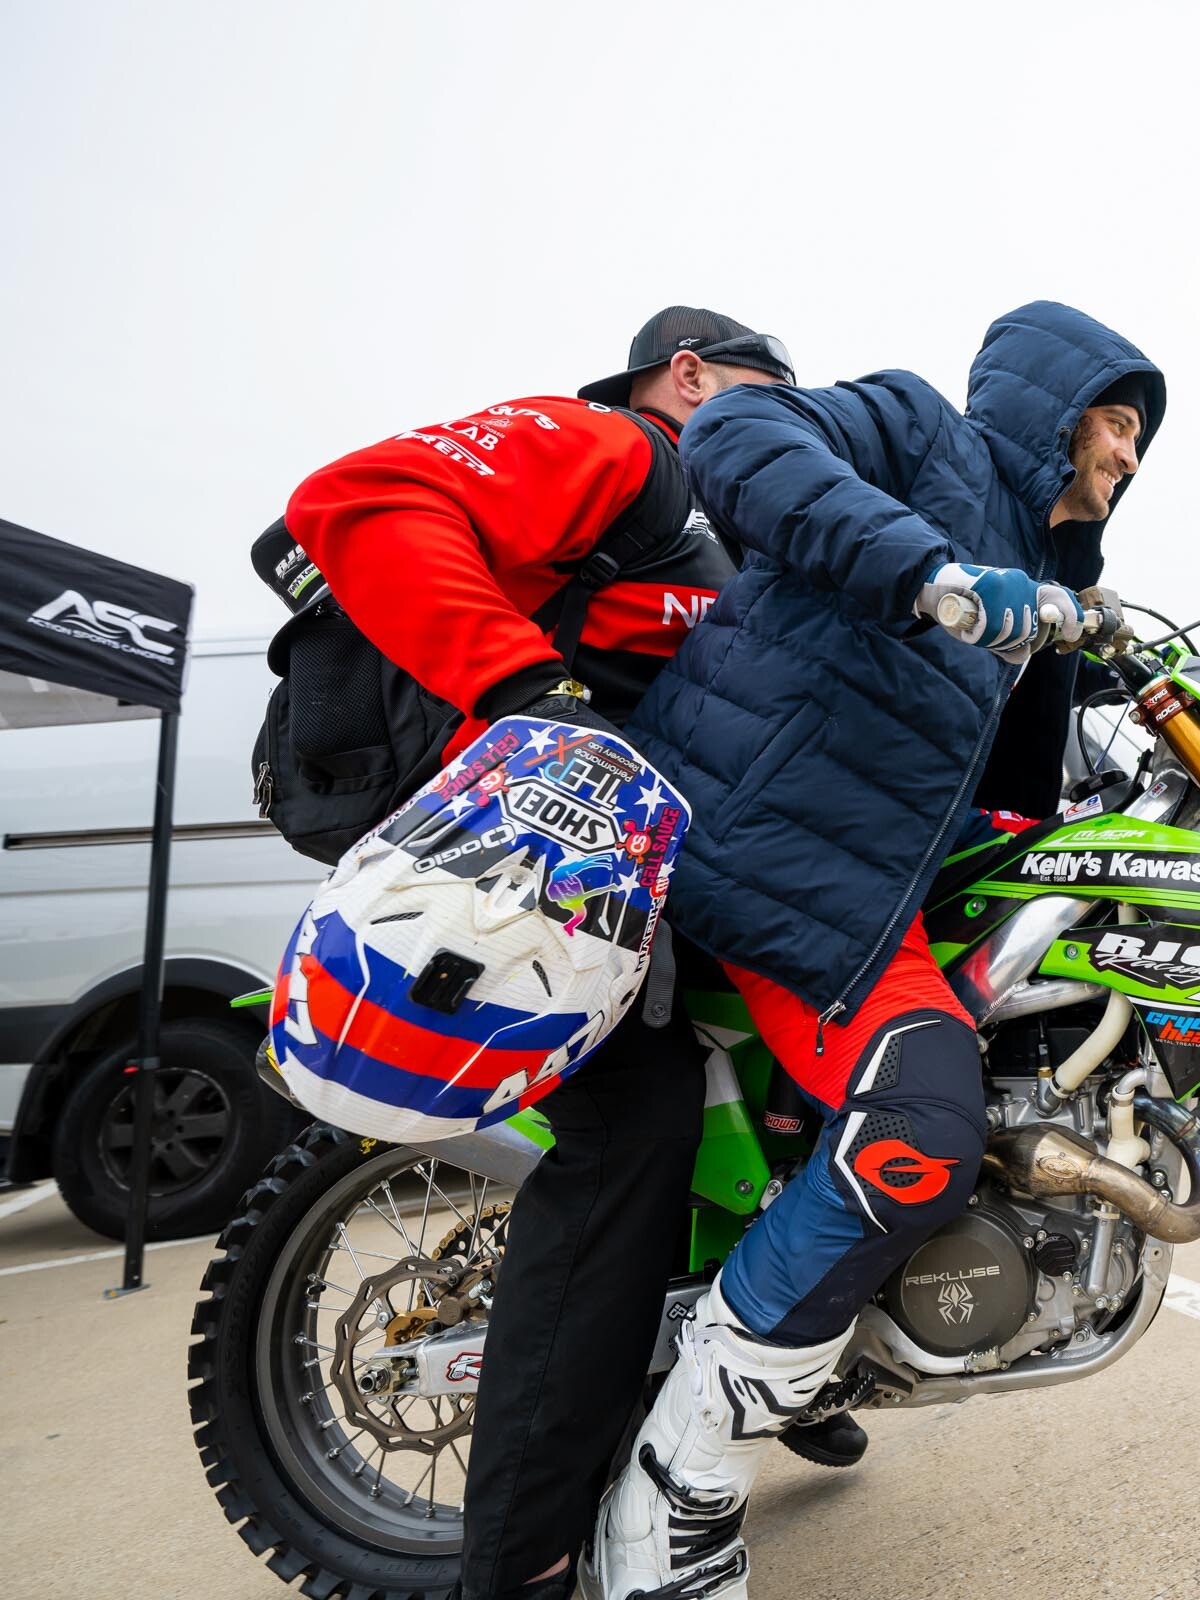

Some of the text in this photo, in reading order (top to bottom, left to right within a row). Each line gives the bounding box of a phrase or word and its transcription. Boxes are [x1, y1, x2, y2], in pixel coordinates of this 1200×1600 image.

[440, 421, 499, 451] LAB
[27, 616, 72, 636] ACTION
[73, 629, 120, 651] SPORTS
[32, 589, 178, 655] ASC
[1155, 700, 1182, 722] ROCS
[574, 748, 634, 784] Performance
[602, 744, 643, 772] Recovery
[513, 787, 607, 848] SHOEI
[641, 852, 665, 887] CELL
[655, 807, 682, 854] SAUCE
[1020, 852, 1103, 883] Kelly's
[1154, 1037, 1174, 1046] METAL
[905, 1265, 1000, 1286] REKLUSE
